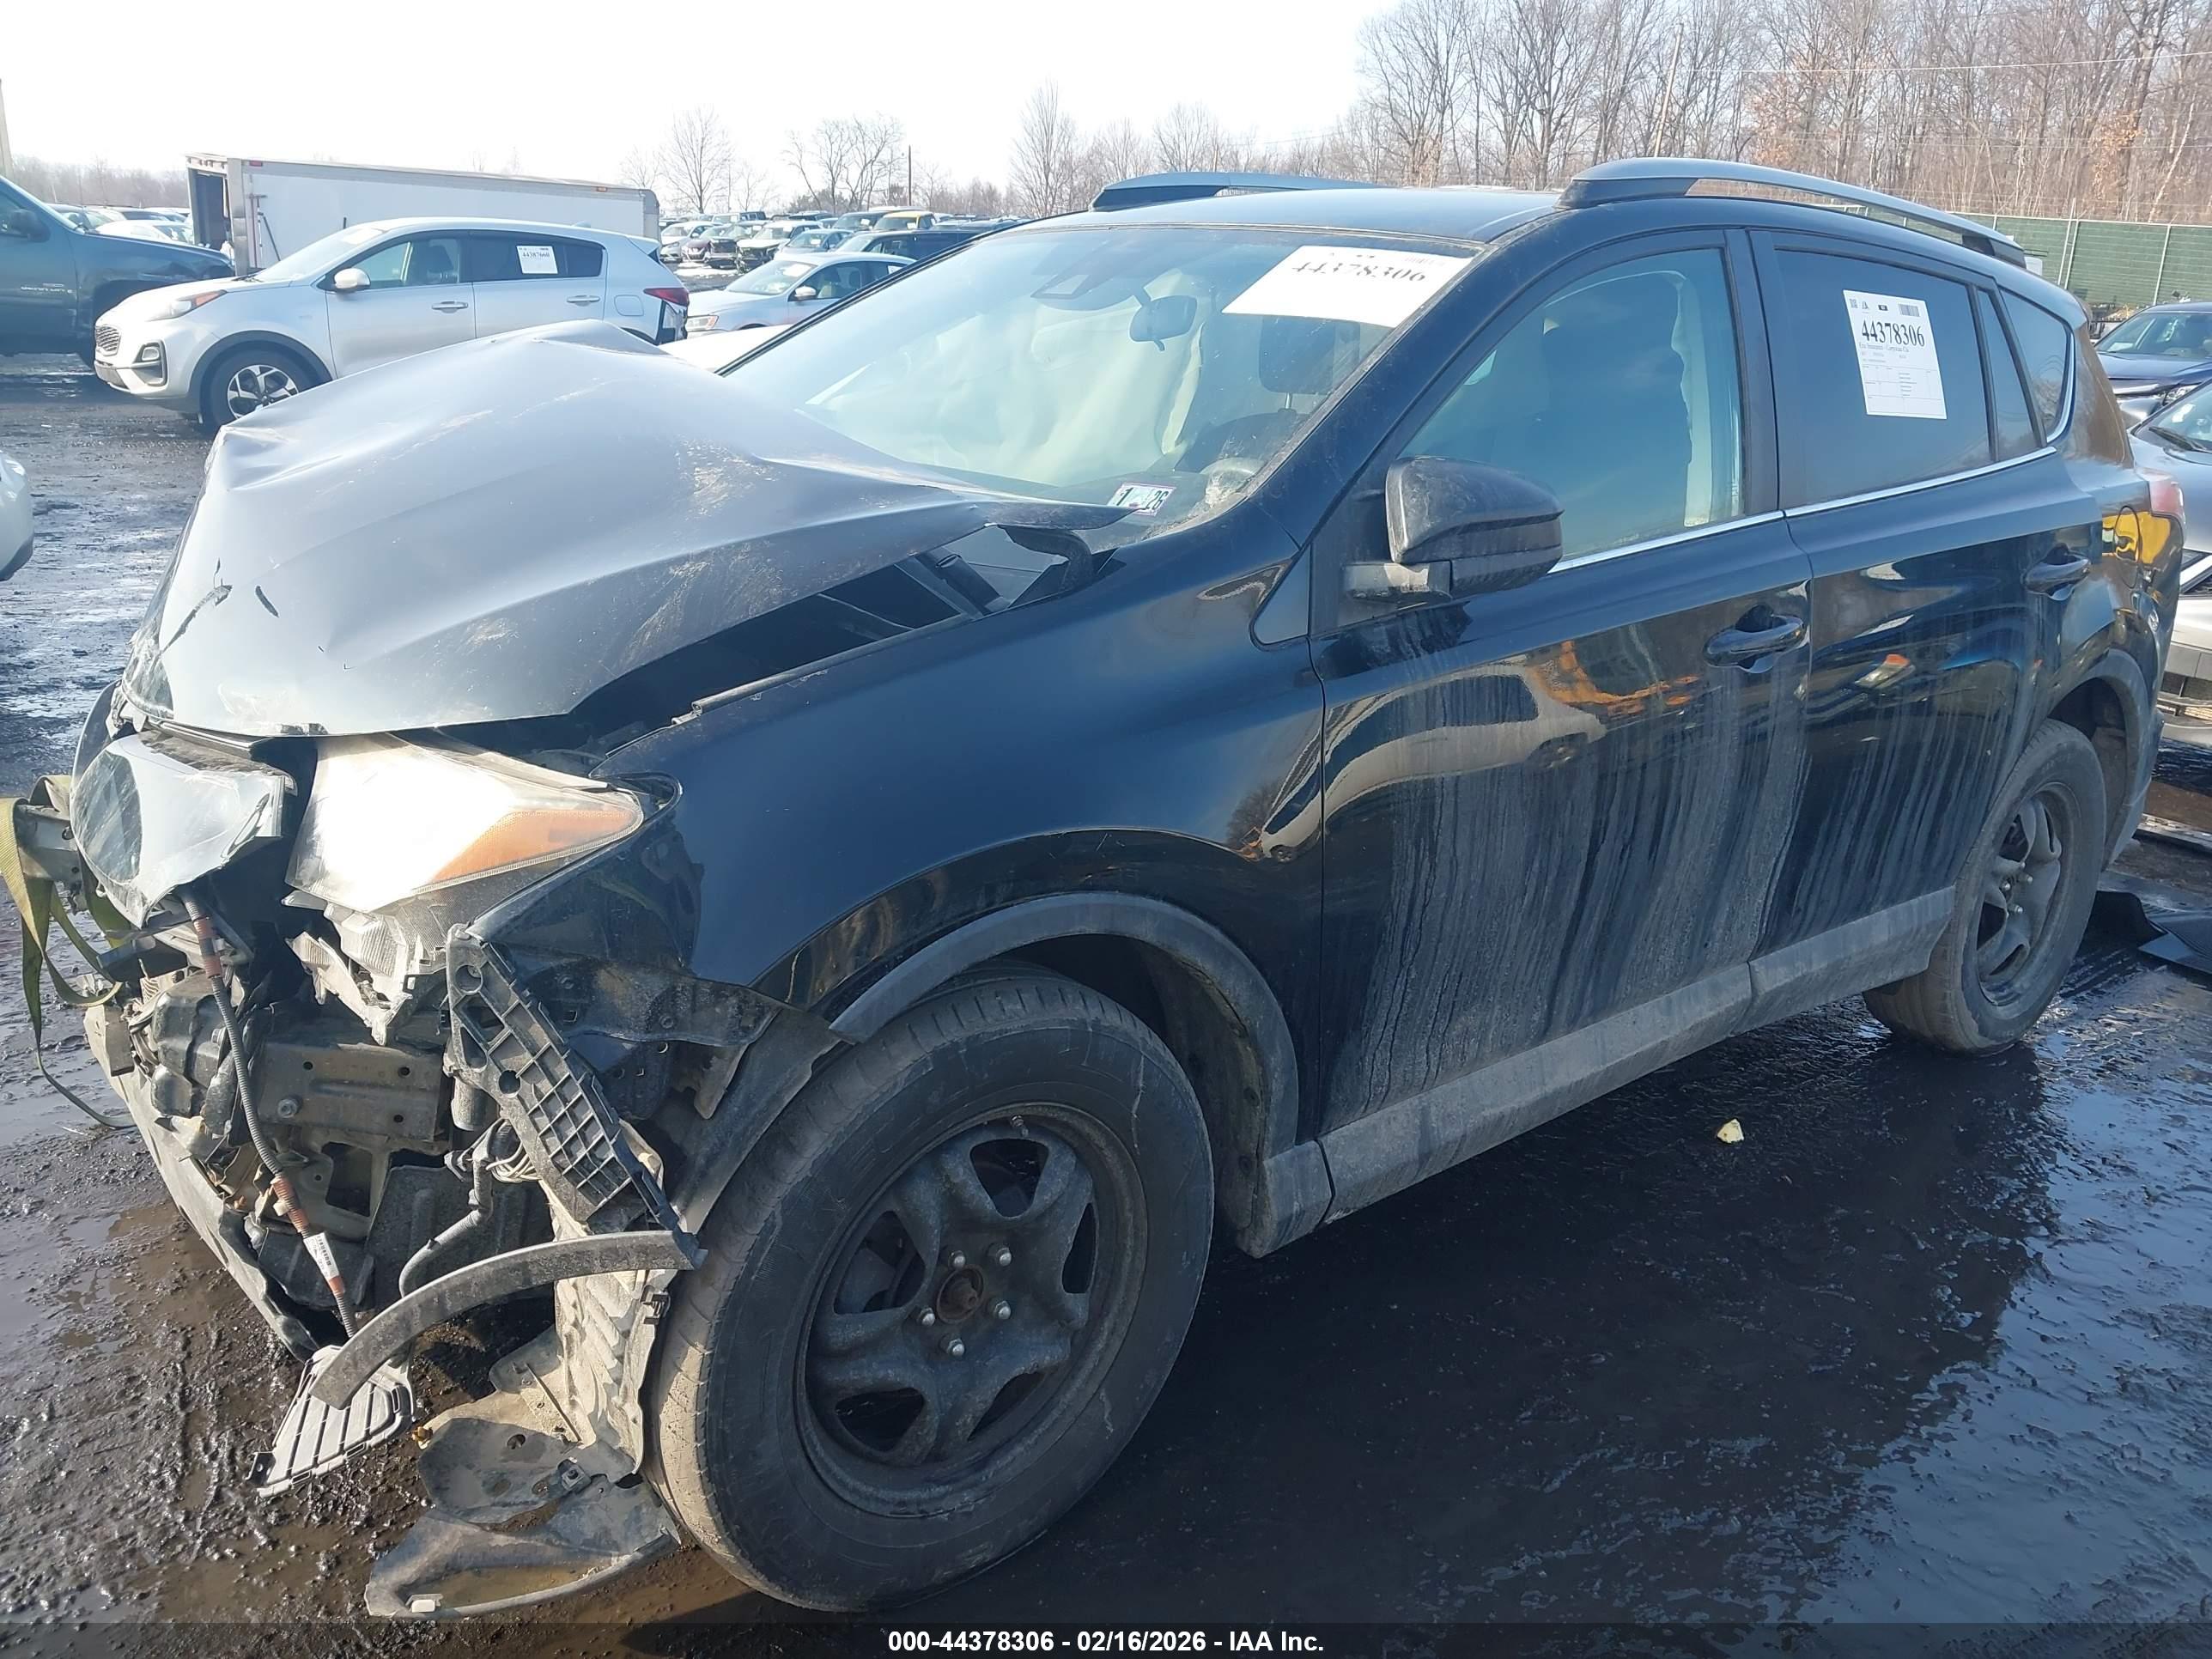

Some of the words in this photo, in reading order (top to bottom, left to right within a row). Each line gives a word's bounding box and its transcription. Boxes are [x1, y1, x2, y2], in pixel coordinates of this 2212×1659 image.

[1292, 261, 1425, 281] 44378306
[1862, 319, 1925, 347] 44378306
[1146, 490, 1169, 510] 26
